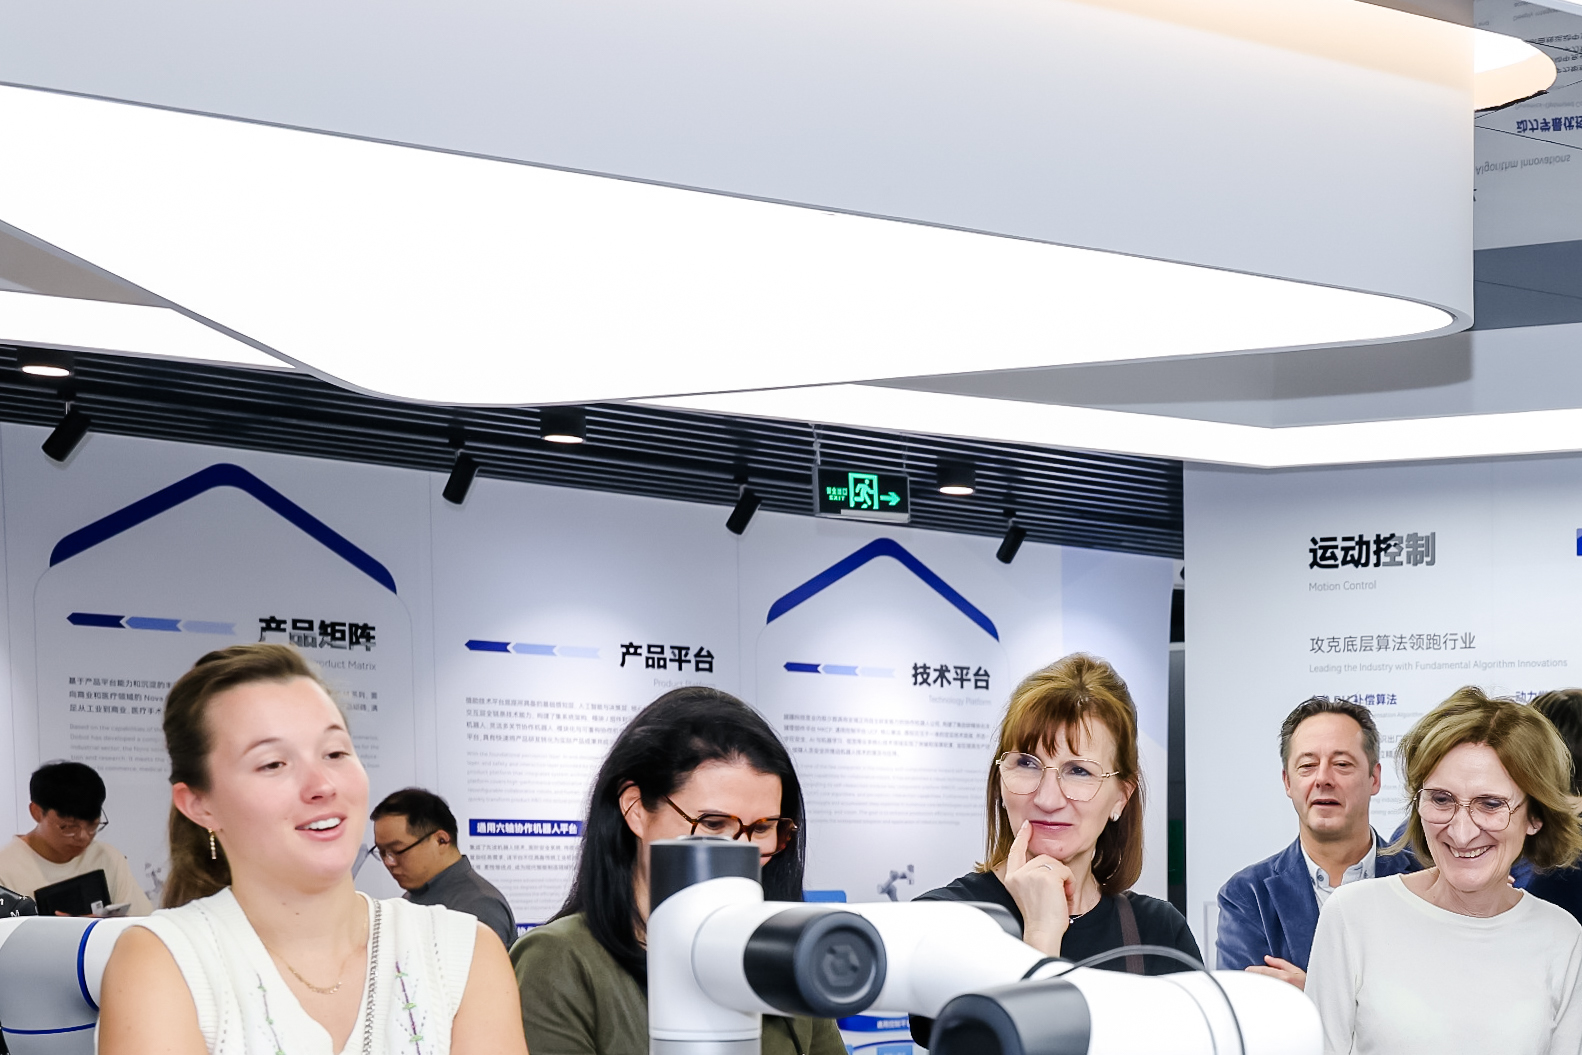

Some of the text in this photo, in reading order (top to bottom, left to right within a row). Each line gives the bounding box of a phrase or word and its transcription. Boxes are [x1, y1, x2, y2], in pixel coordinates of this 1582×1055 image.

[1309, 532, 1437, 570] 运动控制
[1309, 580, 1377, 592] Motion Control
[258, 615, 377, 652] 产品矩阵
[1309, 632, 1477, 655] 攻克底层算法领跑行业
[316, 659, 377, 672] roduct Matrix
[620, 642, 715, 675] 产品平台
[1309, 659, 1568, 675] Leading the Industry with Fundamental Algorithm Innovations
[912, 663, 991, 692] 技术平台
